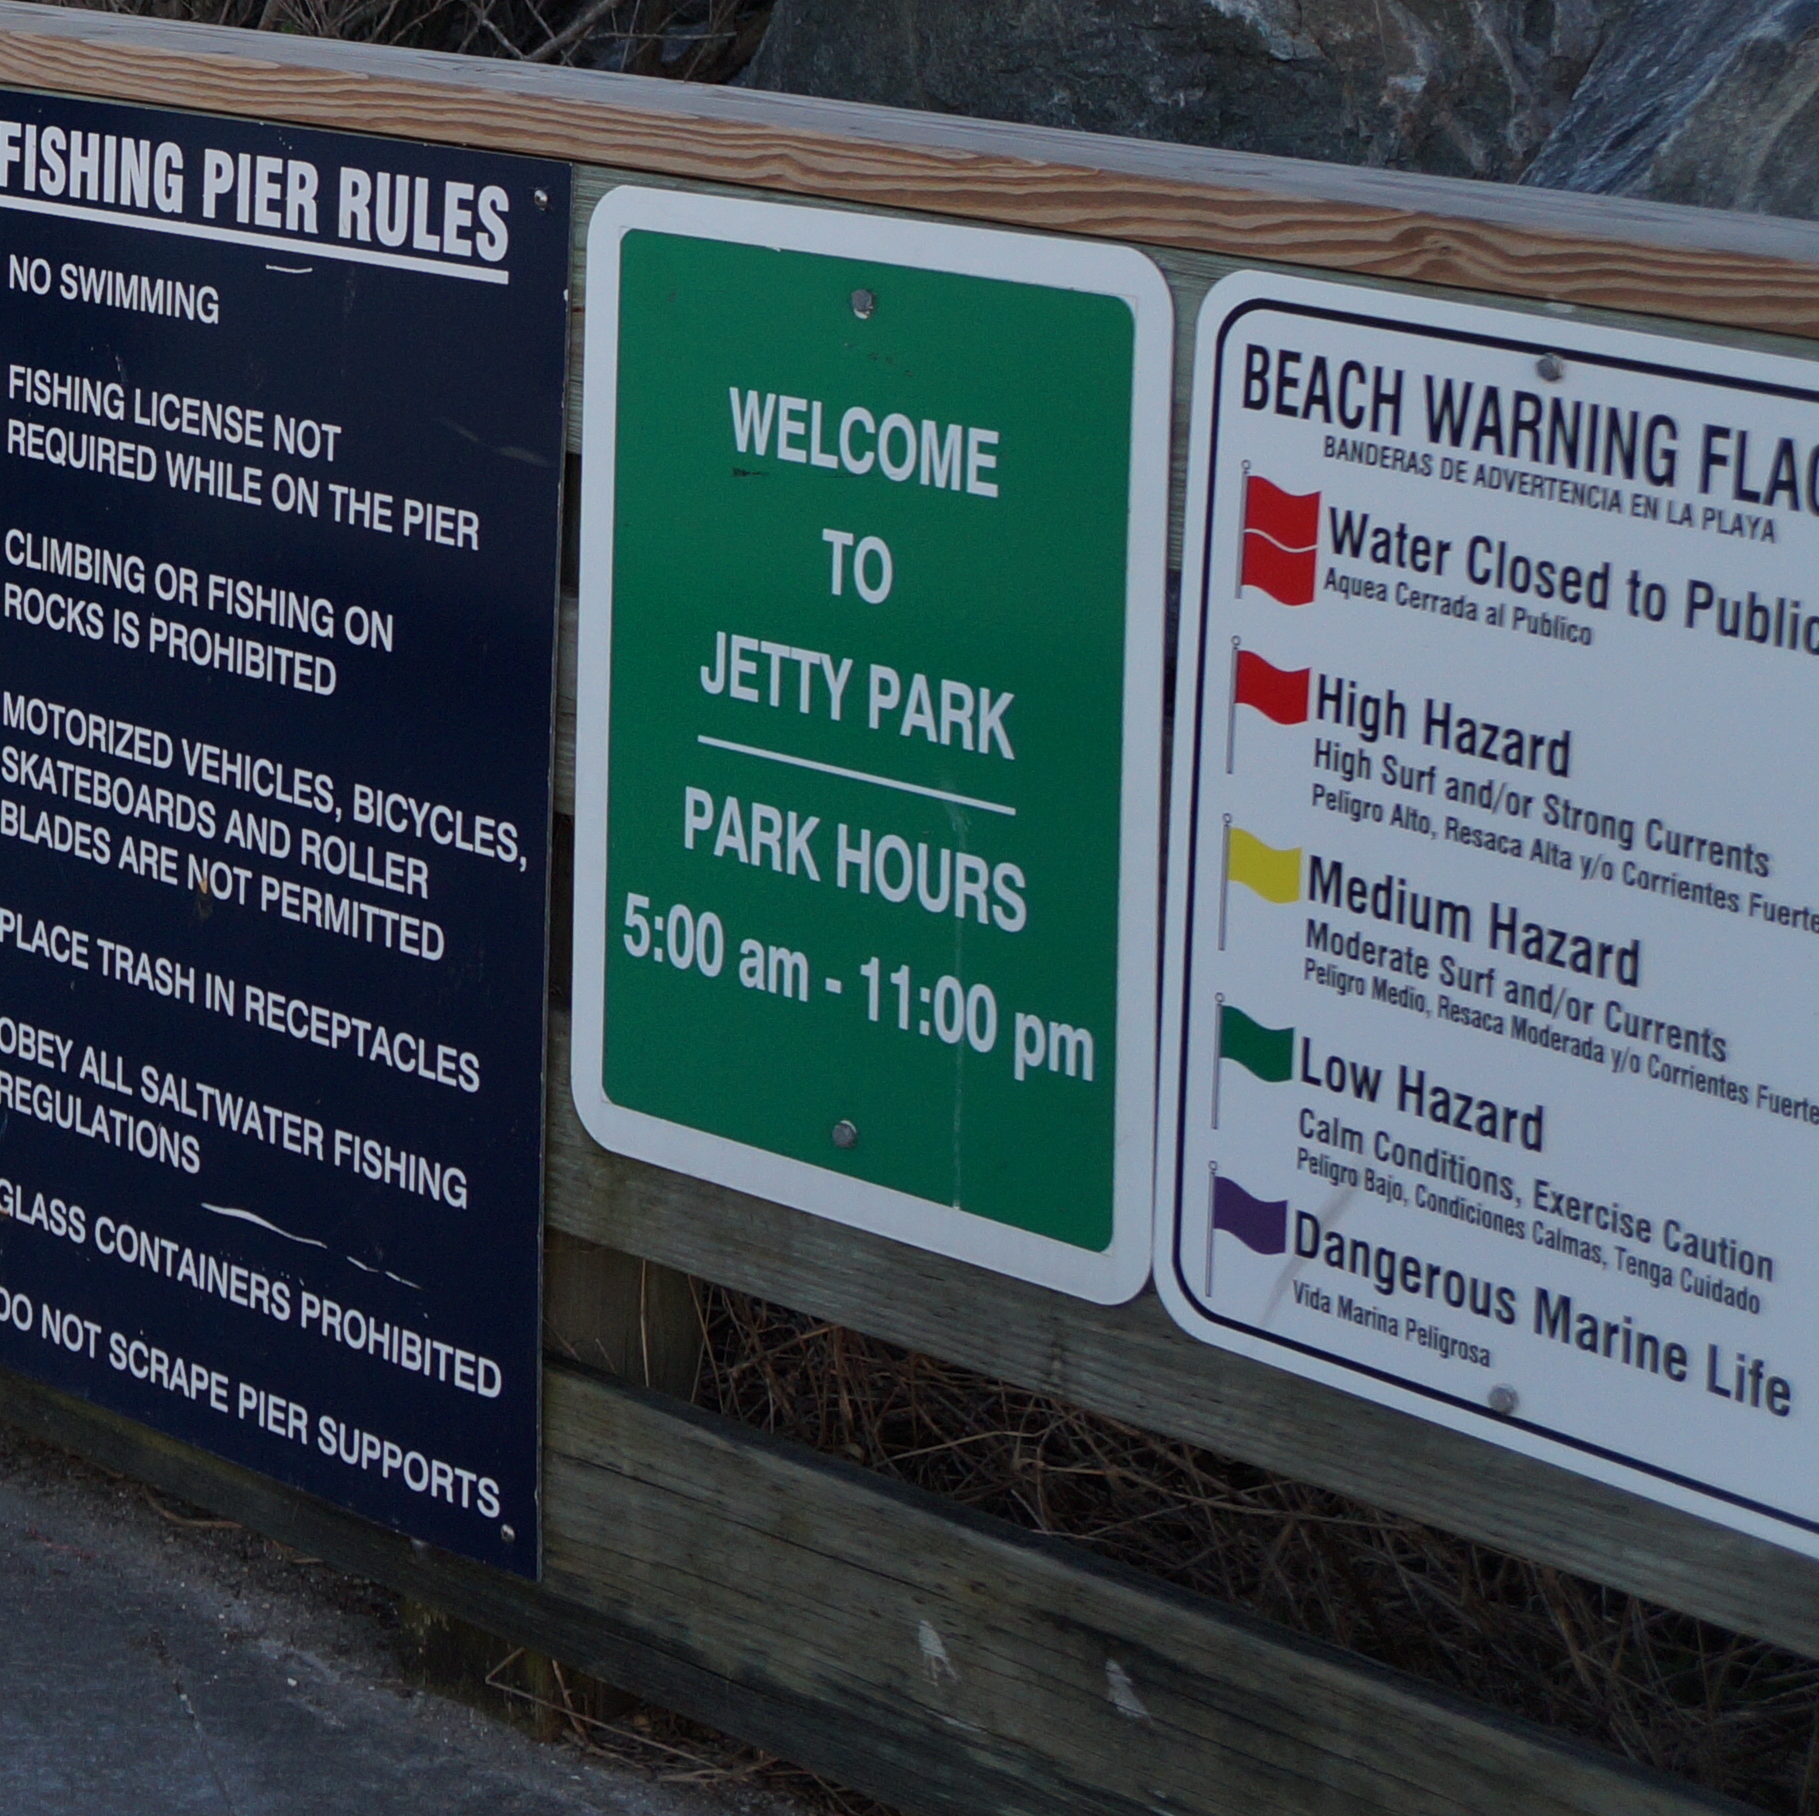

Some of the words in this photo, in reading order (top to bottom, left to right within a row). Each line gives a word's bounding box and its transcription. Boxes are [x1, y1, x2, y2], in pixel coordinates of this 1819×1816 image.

[203, 149, 318, 234] PIER
[339, 167, 509, 261] RULES
[10, 255, 51, 294] NO
[60, 263, 218, 324] SWIMMING
[10, 365, 124, 420] FISHING
[135, 389, 263, 448] LICENSE
[274, 415, 341, 461] NOT
[730, 387, 999, 497] WELCOME
[1242, 343, 1404, 436] BEACH
[1424, 375, 1678, 487] WARNING
[8, 419, 156, 482] REQUIRED
[166, 451, 262, 505] WHILE
[272, 473, 318, 517] ON
[329, 484, 393, 532] THE
[404, 499, 478, 550] PIER
[1324, 435, 1433, 477] BANDERAS
[1440, 457, 1468, 483] DE
[1473, 464, 1622, 513] ADVERTENCIA
[1631, 493, 1659, 520] EN
[1667, 501, 1694, 527] LA
[1702, 507, 1775, 543] PLAYA
[5, 529, 144, 594] CLIMBING
[155, 563, 198, 606] OR
[209, 574, 333, 638] FISHING
[345, 606, 392, 652] ON
[823, 529, 892, 603] TO
[1323, 567, 1387, 600] Aquea
[1394, 581, 1478, 622] Cerrada
[1486, 604, 1504, 627] al
[1512, 607, 1592, 646] Publico
[1329, 507, 1452, 576] Water
[1467, 535, 1610, 610] Closed
[1627, 570, 1667, 622] to
[5, 583, 103, 639] ROCKS
[114, 609, 139, 648] IS
[150, 618, 336, 695] PROHIBITED
[701, 632, 853, 720] JETTY
[870, 664, 1014, 759] PARK
[4, 692, 173, 768] MOTORIZED
[182, 739, 342, 822] VEHICLES,
[354, 784, 527, 872] BICYCLES,
[1316, 673, 1406, 743] High
[1423, 698, 1571, 778] Hazard
[2, 746, 215, 838] SKATEBOARDS
[224, 810, 290, 858] AND
[302, 829, 428, 899] ROLLER
[685, 787, 820, 881] PARK
[838, 824, 1026, 932] HOURS
[1312, 783, 1384, 822] Peligro
[1390, 804, 1436, 839] Alto,
[1445, 816, 1523, 857] Resaca
[1530, 839, 1572, 870] Alta
[1580, 854, 1614, 881] y/o
[1622, 861, 1740, 913] Corrientes
[1314, 738, 1371, 782] High
[1381, 755, 1436, 795] Surf
[1445, 777, 1534, 818] and/or
[1543, 794, 1634, 851] Strong
[1646, 818, 1769, 877] Currents
[1, 800, 110, 864] BLADES
[119, 836, 178, 885] ARE
[188, 854, 252, 904] NOT
[261, 875, 444, 960] PERMITTED
[1308, 855, 1471, 942] Medium
[1489, 902, 1640, 988] Hazard
[0, 908, 88, 969] PLACE
[97, 939, 194, 1003] TRASH
[206, 973, 234, 1016] IN
[246, 985, 479, 1092] RECEPTACLES
[624, 893, 723, 976] 5:00
[740, 939, 808, 1001] am
[861, 957, 997, 1052] 11:00
[1015, 1013, 1093, 1081] pm
[1305, 958, 1365, 996] Peligro
[1372, 976, 1430, 1017] Medio,
[1438, 995, 1504, 1035] Resaca
[1511, 1015, 1604, 1063] Moderada
[1612, 1048, 1640, 1073] y/o
[1648, 1054, 1749, 1105] Corrientes
[1306, 919, 1429, 979] Moderate
[1440, 955, 1495, 997] Surf
[1504, 980, 1594, 1024] and/or
[1605, 1001, 1726, 1062] Currents
[80, 1046, 132, 1095] ALL
[141, 1066, 323, 1160] SALTWATER
[335, 1130, 466, 1209] FISHING
[1299, 1036, 1382, 1103] Low
[1398, 1065, 1543, 1152] Hazard
[1297, 1147, 1360, 1187] Peligro
[1364, 1168, 1407, 1203] Bajo,
[1416, 1184, 1525, 1239] Condiciones
[1532, 1221, 1607, 1268] Calmas,
[1615, 1246, 1673, 1288] Tenga
[1681, 1267, 1760, 1314] Cuidado
[1299, 1108, 1363, 1155] Calm
[1374, 1131, 1521, 1208] Conditions,
[1534, 1179, 1651, 1243] Exercise
[1664, 1219, 1773, 1282] Caution
[95, 1217, 290, 1320] CONTAINERS
[301, 1292, 501, 1397] PROHIBITED
[1293, 1280, 1330, 1314] Vida
[1338, 1295, 1398, 1337] Marina
[1406, 1318, 1490, 1367] Peligrosa
[1294, 1209, 1516, 1325] Dangerous
[1534, 1287, 1687, 1382] Marine
[1707, 1344, 1791, 1417] Life
[42, 1304, 101, 1358] NOT
[109, 1332, 228, 1412] SCRAPE
[239, 1383, 307, 1444] PIER
[318, 1416, 499, 1517] SUPPORTS
